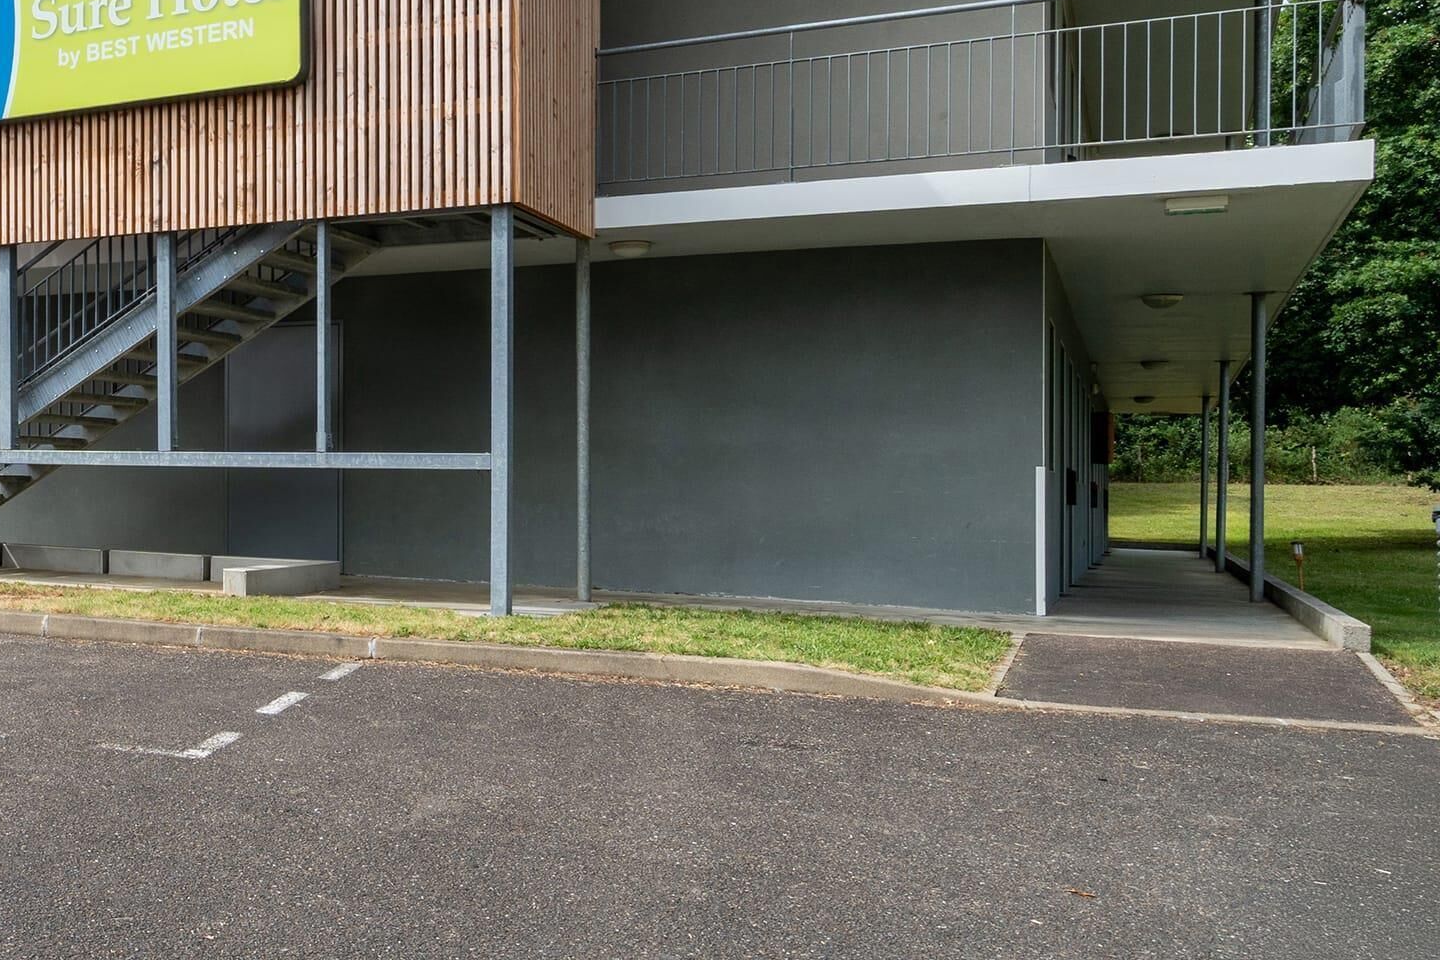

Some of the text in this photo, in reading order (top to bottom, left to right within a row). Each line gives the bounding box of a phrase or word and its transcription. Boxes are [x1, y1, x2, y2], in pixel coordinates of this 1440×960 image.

[57, 17, 254, 69] by BEST WESTERN
